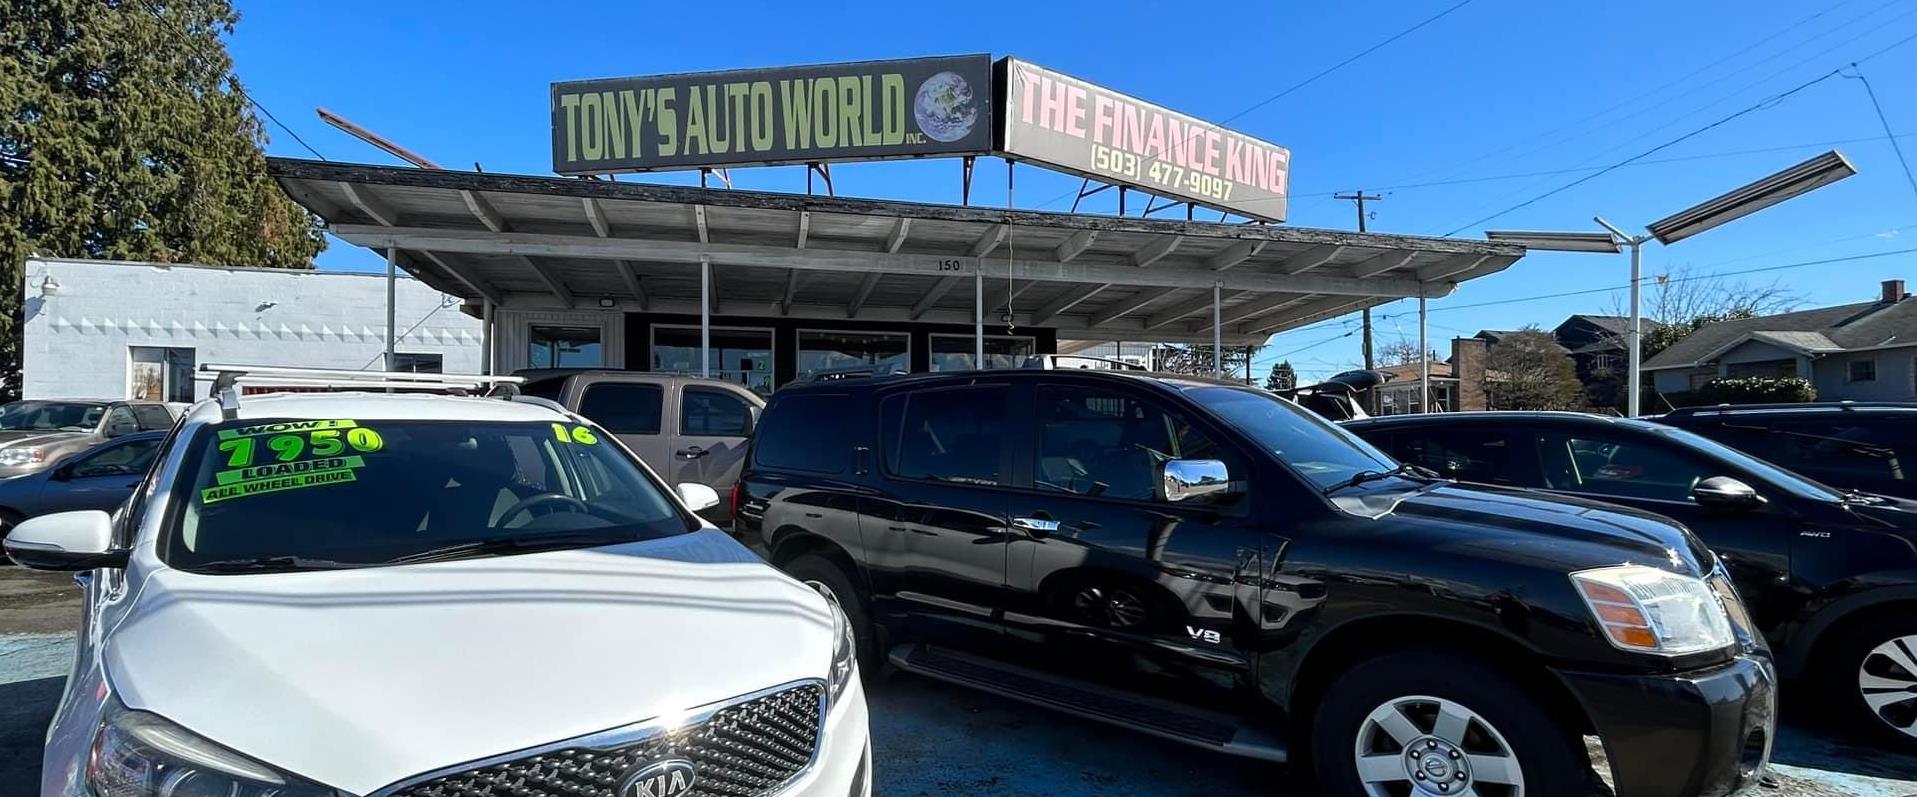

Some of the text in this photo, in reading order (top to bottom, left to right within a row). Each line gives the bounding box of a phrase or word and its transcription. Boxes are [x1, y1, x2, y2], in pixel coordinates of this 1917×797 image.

[561, 73, 927, 162] TONY'S AUTO WORLD INC.
[1021, 71, 1287, 195] THE FINANCE KING
[1090, 144, 1233, 201] (503) 477-9097
[938, 259, 960, 271] 150
[219, 427, 383, 467] 7950
[551, 422, 598, 445] 16
[241, 458, 345, 480] LOADED
[206, 471, 349, 500] ALL WHEEL DRIVE
[1186, 625, 1221, 644] V8
[635, 769, 686, 797] KIA
